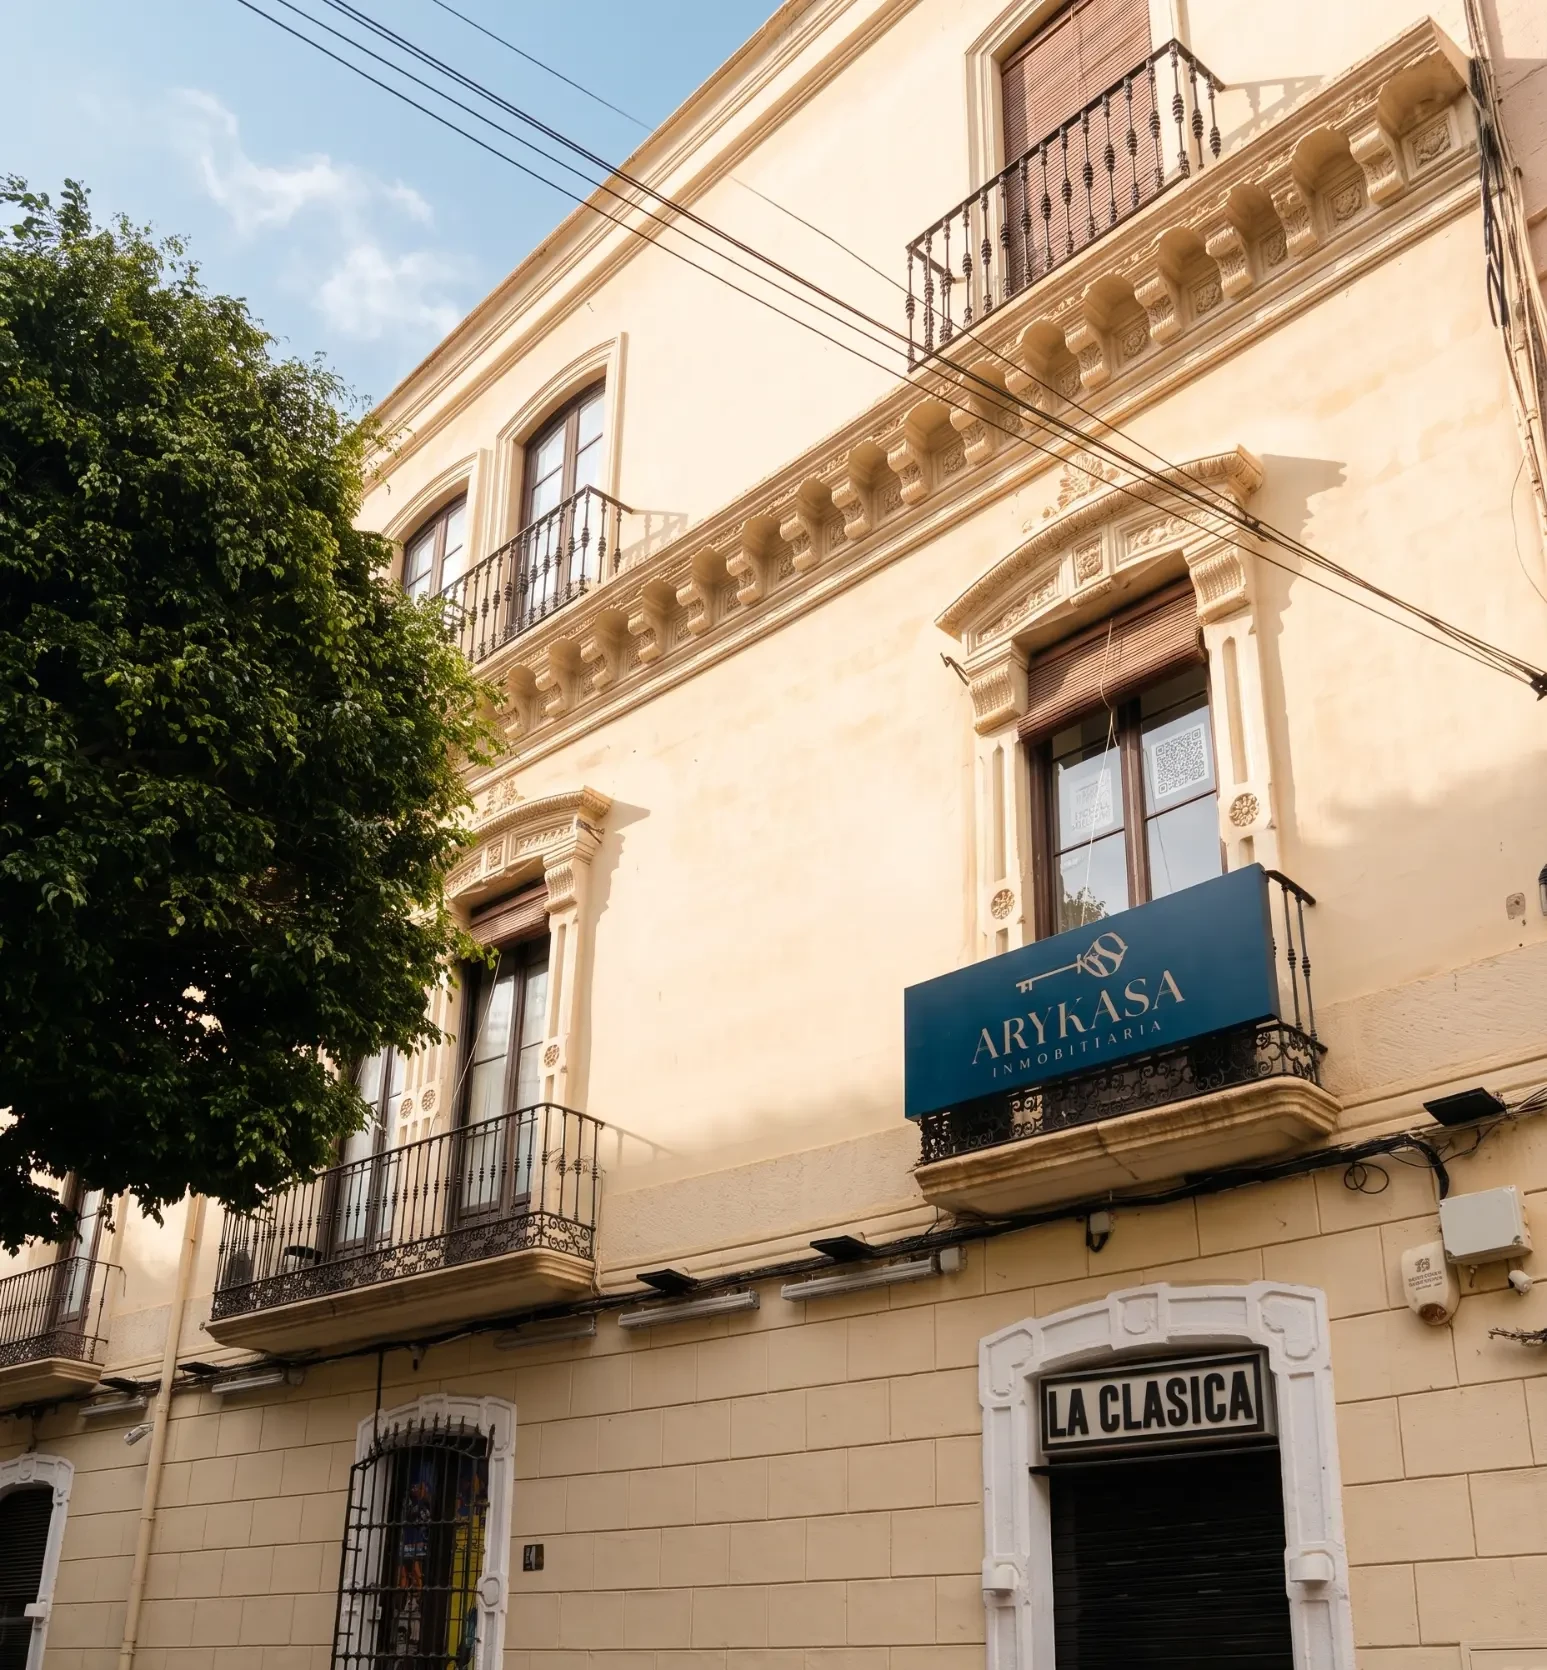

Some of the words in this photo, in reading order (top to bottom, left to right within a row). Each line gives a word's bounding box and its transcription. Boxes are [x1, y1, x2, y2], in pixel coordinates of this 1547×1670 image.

[972, 970, 1185, 1064] ARYKASA
[1049, 1388, 1089, 1438] LA
[1099, 1371, 1254, 1432] CLASICA
